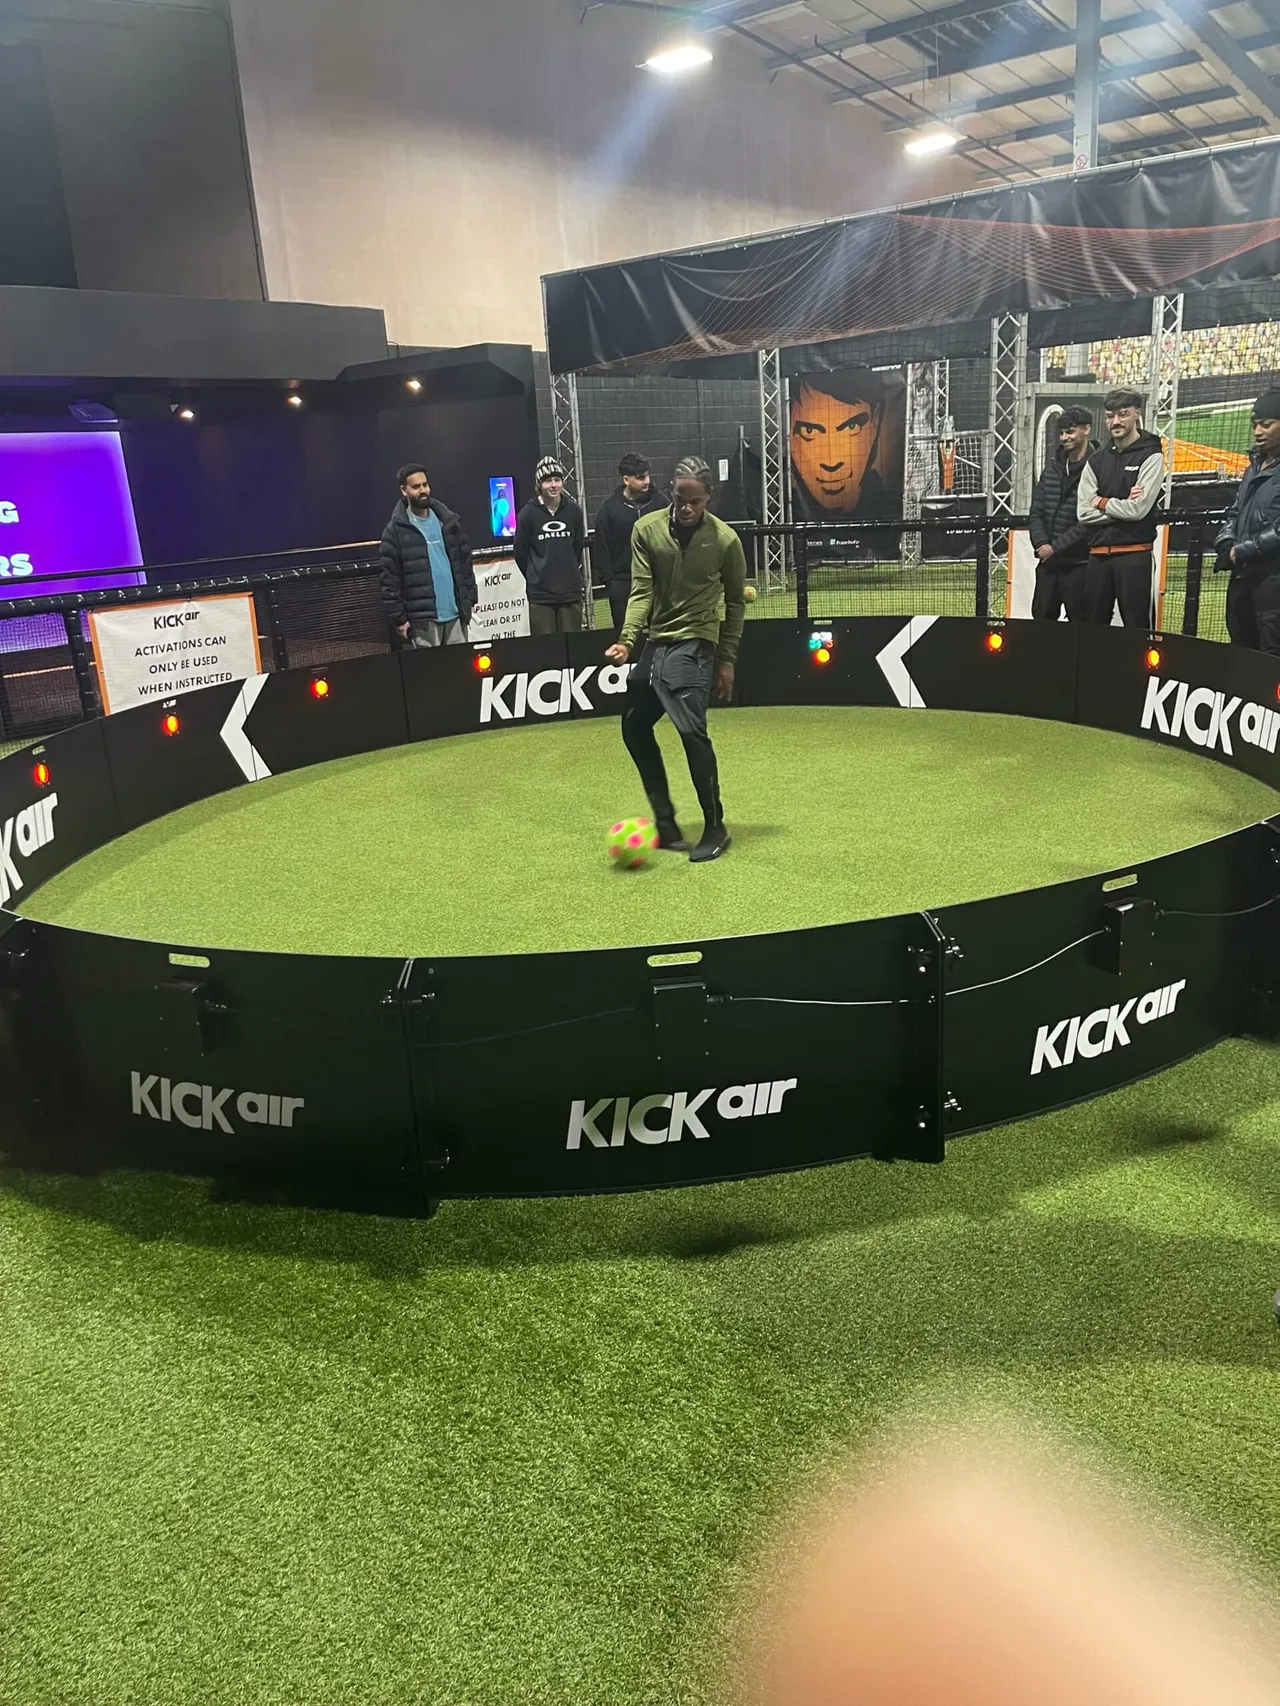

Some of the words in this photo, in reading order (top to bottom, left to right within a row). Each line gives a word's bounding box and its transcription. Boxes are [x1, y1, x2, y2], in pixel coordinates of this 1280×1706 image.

[538, 531, 572, 540] OAKLEY
[499, 600, 509, 609] DO
[511, 598, 526, 607] NOT
[499, 616, 511, 624] OR
[512, 614, 522, 623] SIT
[503, 630, 516, 639] THE
[134, 638, 203, 657] ACTIVATIONS
[204, 636, 227, 647] CAN
[149, 661, 179, 674] ONLY
[180, 659, 190, 669] BE
[193, 655, 218, 667] USED
[138, 681, 173, 696] WHEN
[175, 672, 233, 690] INSTRUCTED
